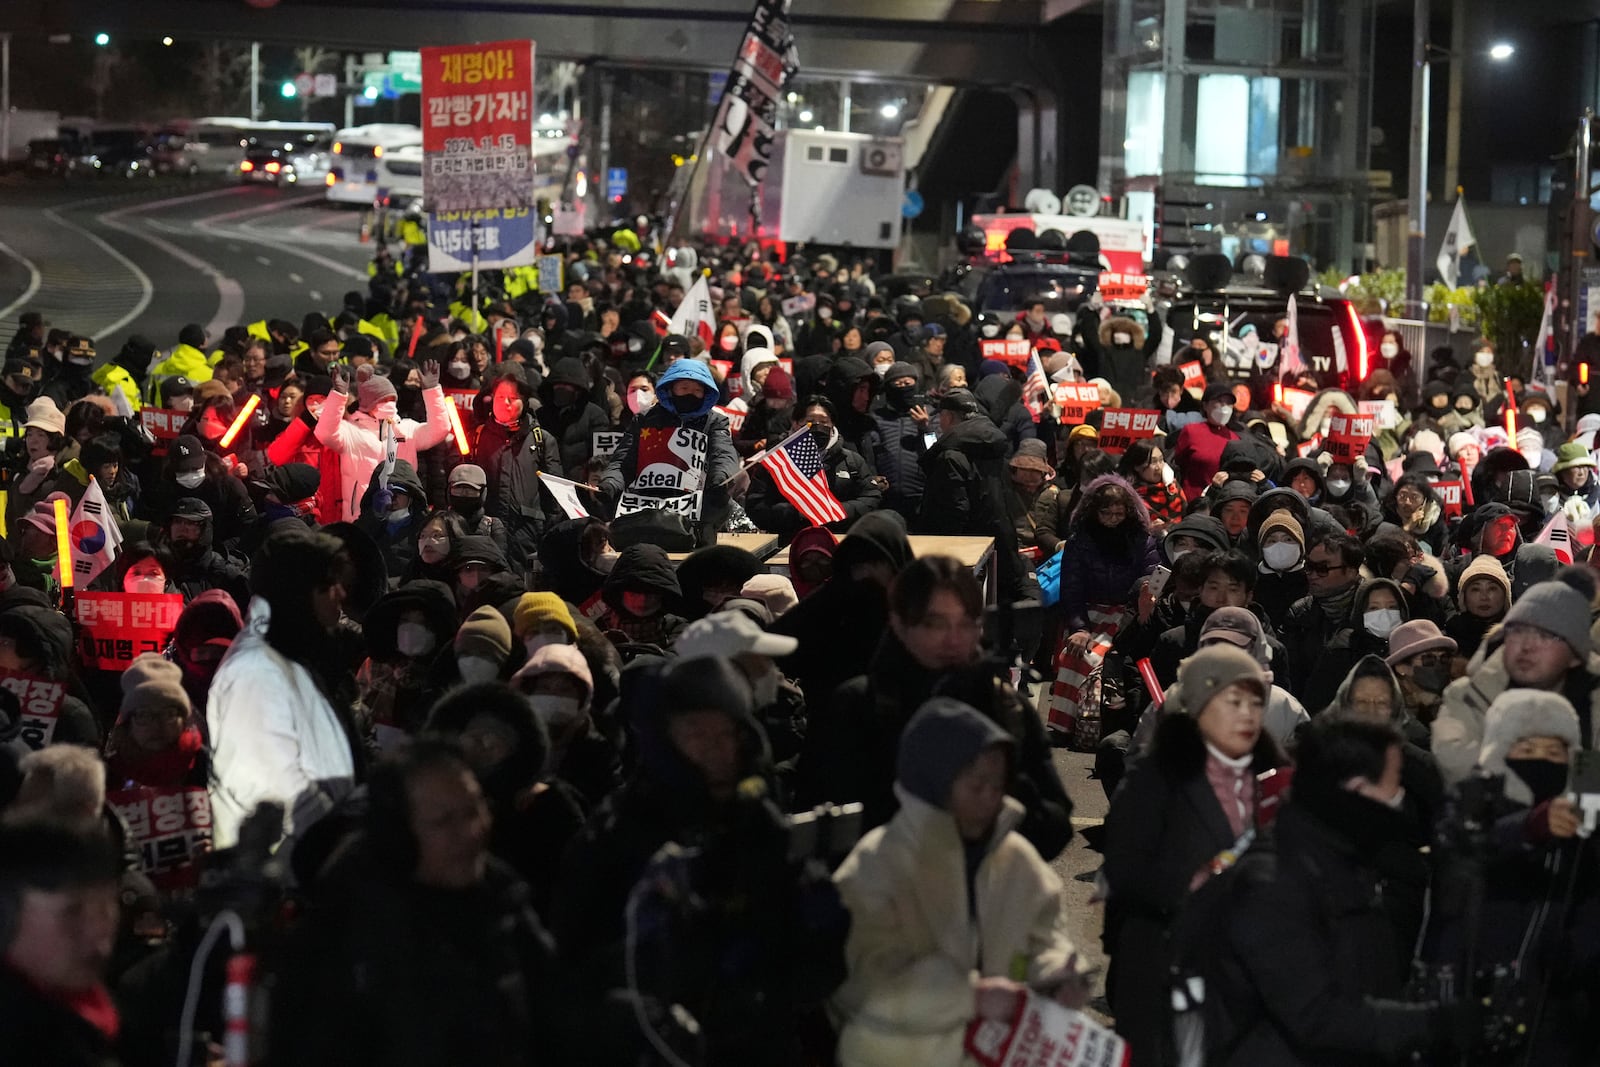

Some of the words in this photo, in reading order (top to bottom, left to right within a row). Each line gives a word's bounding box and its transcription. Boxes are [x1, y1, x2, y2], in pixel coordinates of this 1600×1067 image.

[440, 50, 514, 84] 재명아!
[429, 91, 527, 128] 깜빵가자!
[501, 136, 514, 150] 15
[1312, 356, 1331, 371] TV
[1055, 386, 1078, 401] 탄핵
[1079, 387, 1099, 401] 반대
[142, 411, 168, 432] 탄핵
[172, 415, 190, 432] 반
[1104, 412, 1131, 430] 탄핵
[1132, 413, 1159, 431] 반대
[1351, 419, 1373, 436] 반대
[676, 428, 707, 454] Sto
[639, 471, 683, 488] steal
[77, 599, 124, 627] 탄핵
[131, 601, 180, 629] 반대
